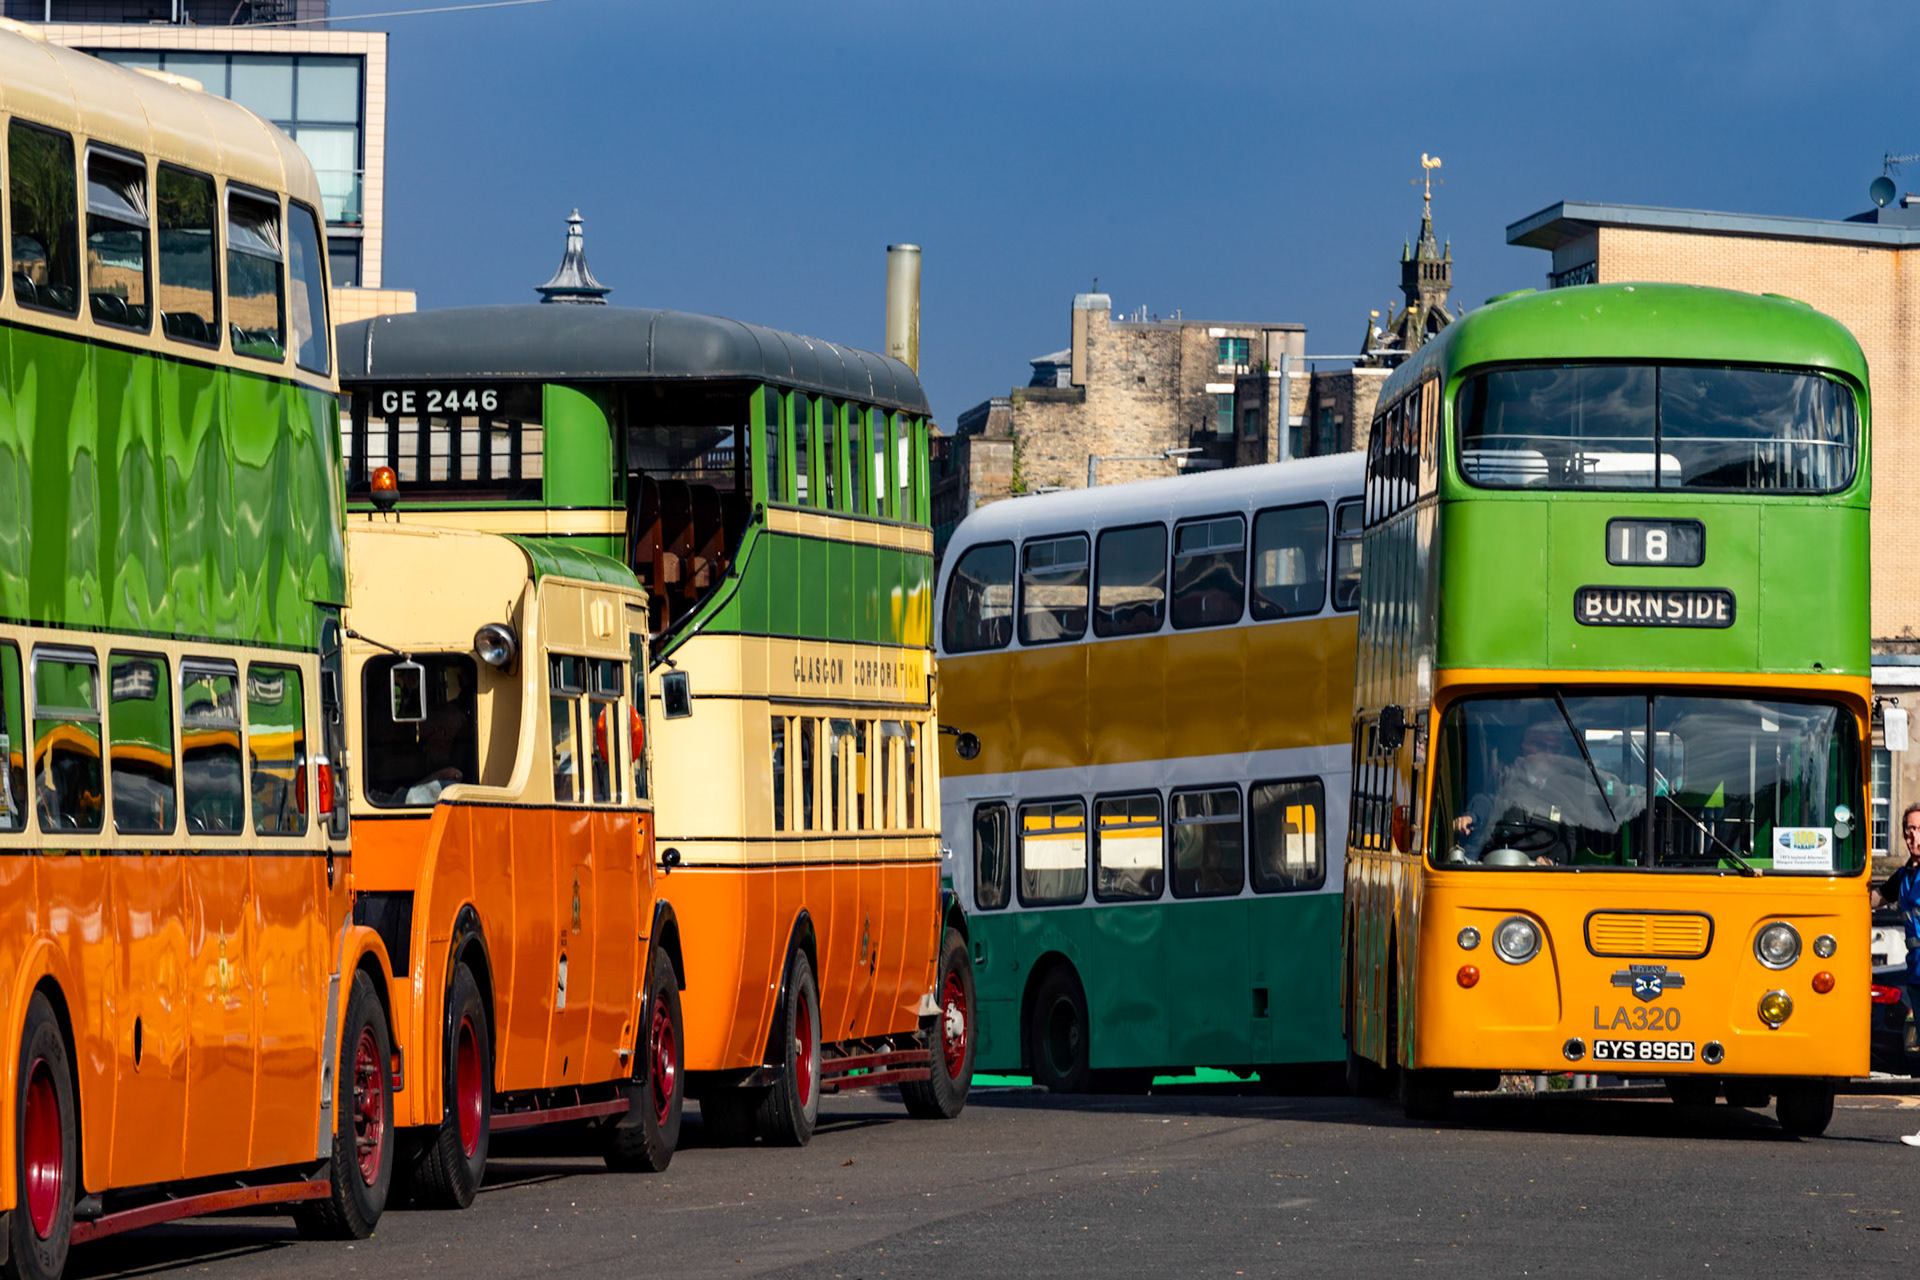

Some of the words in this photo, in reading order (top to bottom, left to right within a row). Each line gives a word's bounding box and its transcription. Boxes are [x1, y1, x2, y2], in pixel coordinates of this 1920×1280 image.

[382, 390, 417, 413] GE
[426, 389, 498, 413] 2446
[1621, 528, 1668, 562] 18
[1585, 591, 1731, 620] BURNSIDE
[793, 655, 844, 684] GLASGOW
[1632, 965, 1666, 974] LEYLAND
[1594, 1006, 1681, 1031] LA320
[1595, 1041, 1636, 1059] GYS
[1639, 1042, 1694, 1060] 896D
